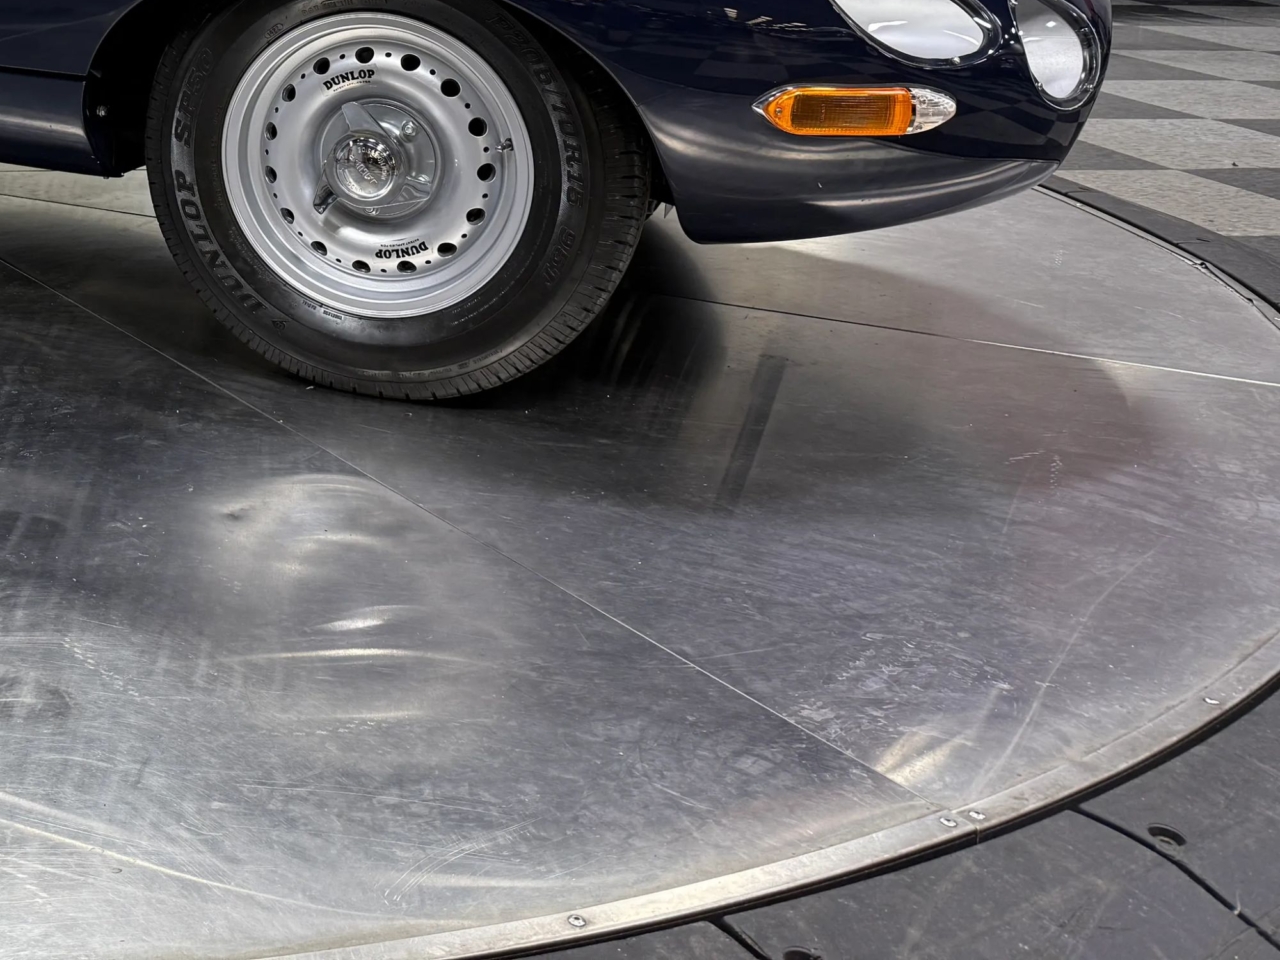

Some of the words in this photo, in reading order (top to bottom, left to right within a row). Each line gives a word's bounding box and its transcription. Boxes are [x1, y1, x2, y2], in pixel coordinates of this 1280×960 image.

[323, 69, 375, 90] DUNLOP
[174, 169, 268, 313] DUNLOP
[374, 241, 429, 259] DUNLOP
